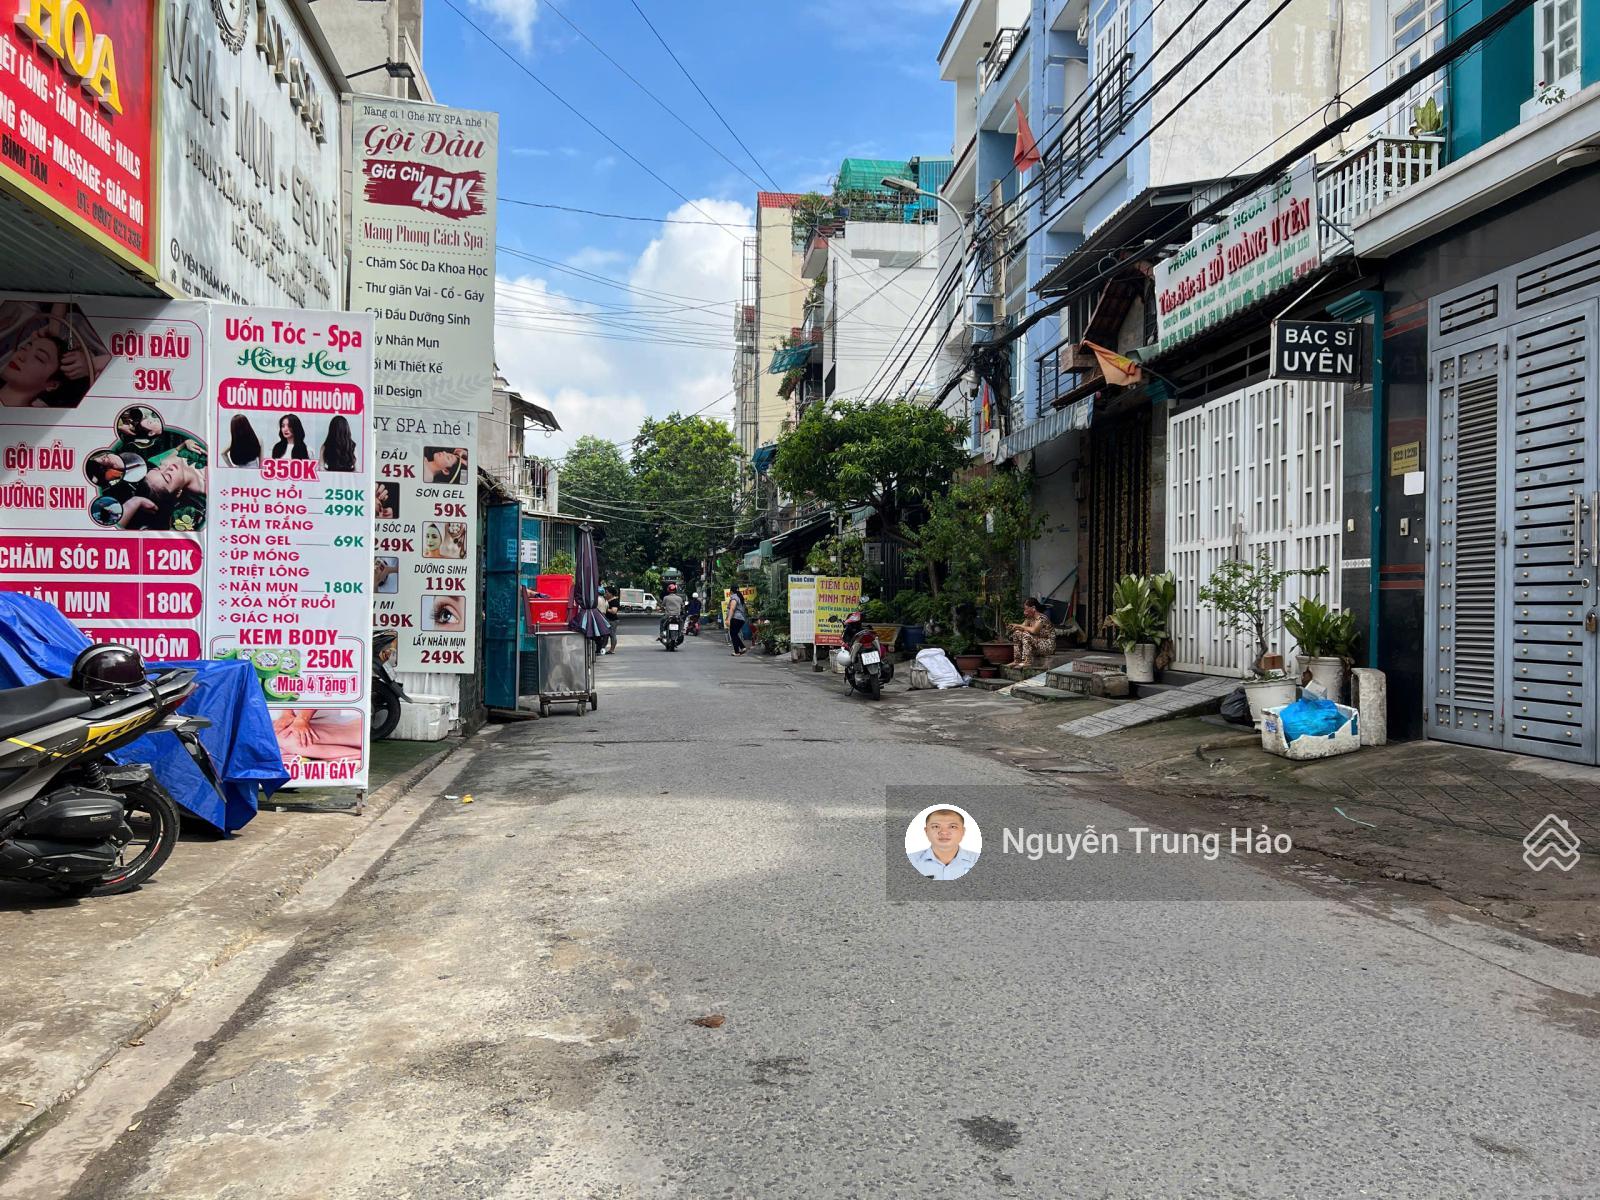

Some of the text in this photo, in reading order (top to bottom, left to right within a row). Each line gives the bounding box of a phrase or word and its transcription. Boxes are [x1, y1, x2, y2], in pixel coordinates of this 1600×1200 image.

[14, 0, 123, 115] HOA
[19, 54, 141, 180] LÔNG TẮM TRẮNG NAILS
[428, 113, 442, 123] NY
[444, 116, 462, 126] SPA
[364, 124, 416, 156] Gội
[2, 132, 48, 185] BÌNH TÂN
[19, 108, 47, 154] SINH
[53, 134, 101, 195] MASSAGE
[106, 179, 127, 214] GIÁC
[129, 194, 144, 228] HƠI
[371, 163, 425, 182] Giá Chỉ
[412, 176, 476, 211] 45K
[363, 222, 483, 251] Mang Phong Cách Spa
[1227, 225, 1268, 275] HOÀNG
[1270, 197, 1311, 247] UYÊN
[366, 257, 488, 279] Chăm Sóc Da Khoa Học
[365, 282, 387, 294] Thư
[415, 286, 431, 297] Vai
[447, 313, 471, 325] Sinh
[225, 317, 264, 343] Uốn
[271, 322, 306, 345] Tóc
[328, 324, 362, 352] Spa
[417, 336, 440, 350] Mụn
[1285, 325, 1356, 346] BÁC SĨ
[111, 328, 190, 361] GỘI ĐẦU
[237, 346, 351, 377] Hồng Hoa
[385, 360, 396, 371] Mi
[429, 361, 443, 373] Kế
[1283, 346, 1353, 374] UYÊN
[134, 368, 172, 392] 39K
[226, 381, 356, 414] UỐN DUỖI NHUỘM
[386, 385, 422, 398] Design
[396, 418, 427, 434] SPA
[432, 420, 461, 435] nhé
[5, 441, 74, 474] GỘI ĐẦU
[262, 459, 318, 480] 350K
[381, 464, 416, 478] 45K
[49, 487, 85, 508] SINH
[276, 484, 303, 499] HỒI
[324, 488, 365, 501] 250K
[416, 488, 465, 499] SƠN GEL
[264, 501, 307, 515] BÓNG
[324, 504, 365, 517] 499K
[434, 503, 467, 517] 59K
[382, 521, 402, 533] SÓC
[403, 524, 416, 533] DA
[230, 533, 364, 547] SƠN GEL 69K
[60, 544, 99, 570] SÓC
[105, 549, 130, 570] DA
[146, 550, 193, 571] 120K
[230, 548, 300, 561] ÚP MÓNG
[230, 564, 310, 579] TRIỆT LÔNG
[447, 565, 468, 575] SINH
[266, 582, 298, 596] MỤN
[324, 581, 364, 593] 180K
[425, 577, 466, 591] 119K
[65, 591, 110, 618] MỤN
[146, 592, 193, 614] 180K
[230, 594, 336, 609] XÓA NỐT RUỒI
[380, 601, 395, 609] MI
[818, 593, 839, 604] MINH
[230, 611, 299, 623] GIÁC HƠI
[239, 629, 339, 646] KEM BODY
[306, 649, 354, 668] 250K
[421, 650, 465, 664] 249K
[276, 676, 357, 696] Mua 4 Tặng 1
[304, 759, 356, 779] VAI GÁY
